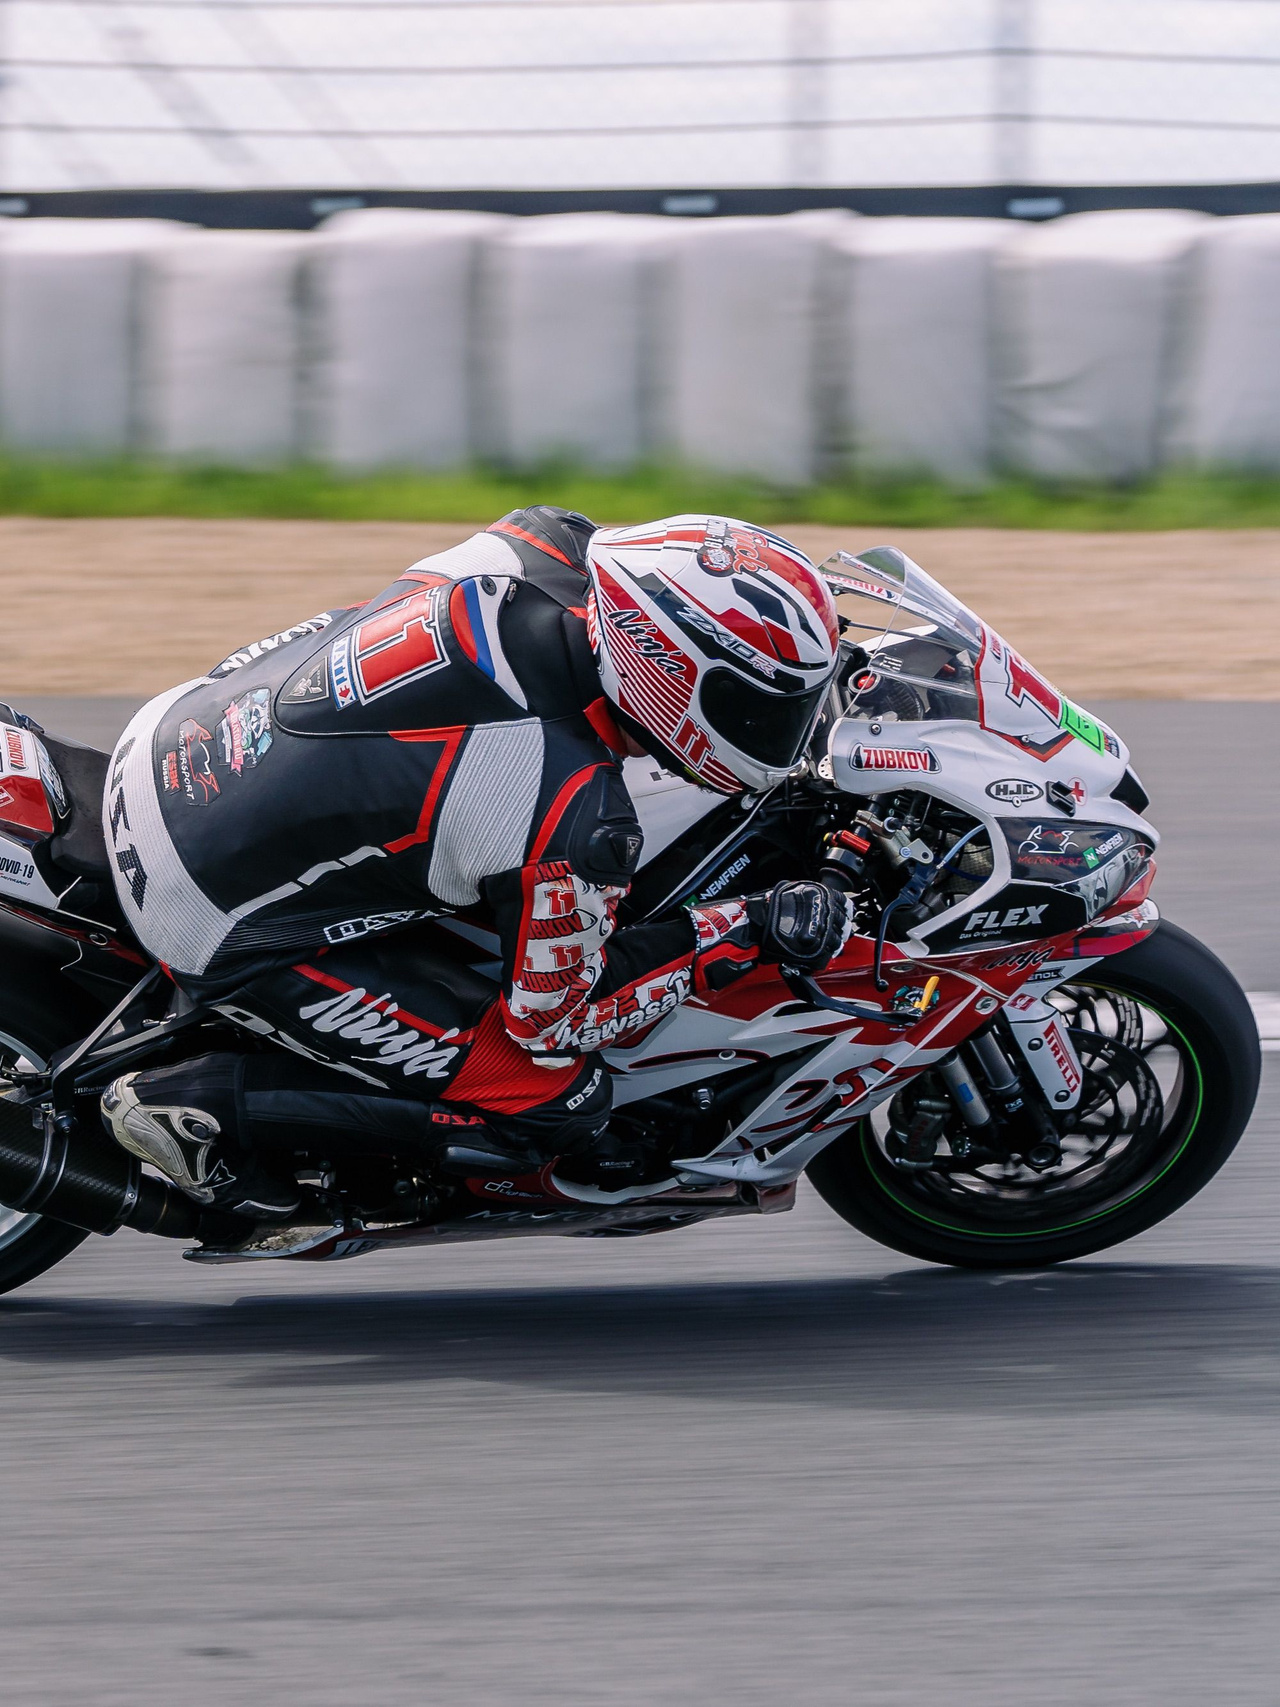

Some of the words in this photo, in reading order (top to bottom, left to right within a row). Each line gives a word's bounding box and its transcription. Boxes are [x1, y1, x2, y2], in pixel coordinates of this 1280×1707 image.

[607, 609, 685, 681] Ninja
[6, 731, 24, 767] ZUBKOV
[671, 714, 716, 771] 11
[161, 759, 170, 789] RUSSIA
[179, 730, 195, 800] MOTORSPORT
[863, 748, 930, 772] ZUBKOV
[995, 784, 1035, 797] HJC
[699, 854, 751, 900] NEWFREN
[545, 888, 579, 916] 11
[963, 904, 1050, 932] FLEX
[959, 932, 972, 940] Das
[973, 929, 1003, 938] Original
[548, 943, 584, 968] 11
[299, 987, 460, 1078] Ninja
[1043, 1020, 1081, 1093] PIRELLI
